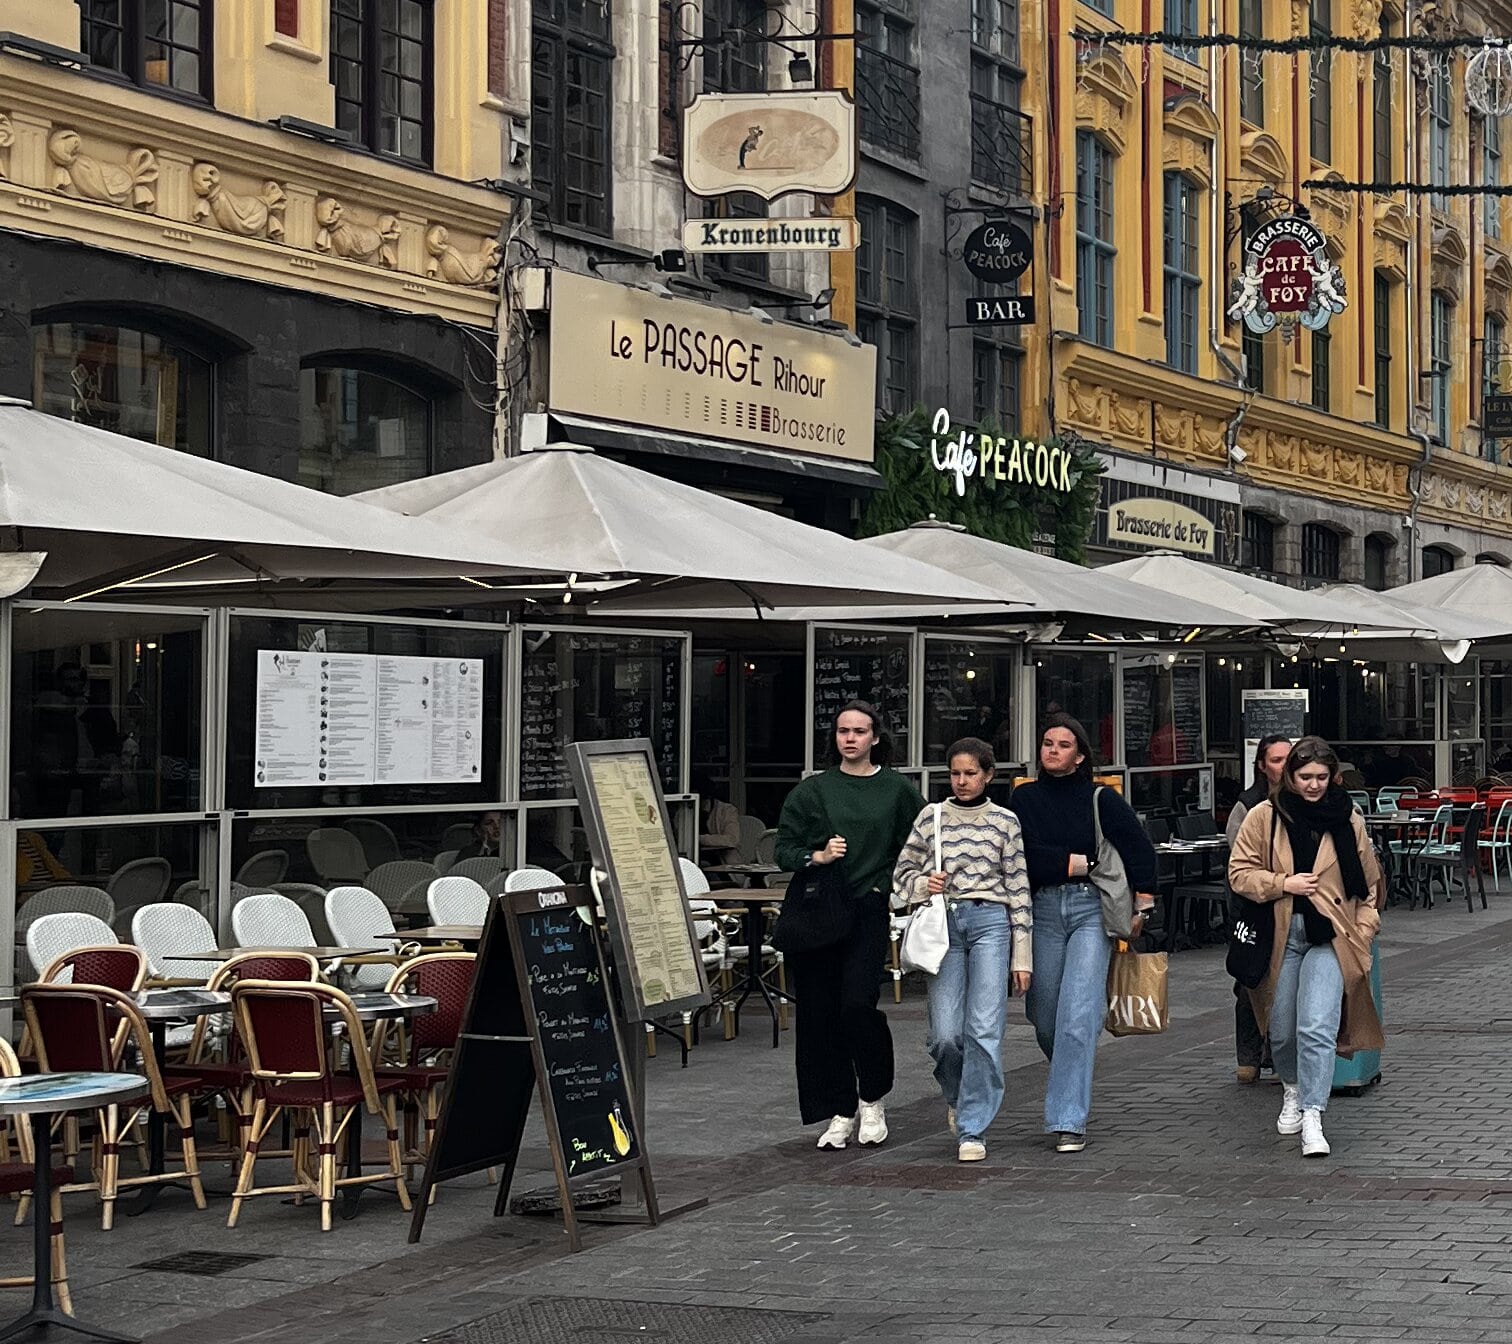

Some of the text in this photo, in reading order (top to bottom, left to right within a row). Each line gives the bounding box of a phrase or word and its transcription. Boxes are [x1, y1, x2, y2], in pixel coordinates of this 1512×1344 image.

[701, 222, 841, 248] Kronenbourg
[983, 227, 1012, 254] Café
[1252, 221, 1319, 253] BRASSERIE
[968, 250, 1027, 270] PEACOCK
[1281, 274, 1296, 284] de
[1270, 286, 1307, 303] FOY
[975, 300, 1026, 320] BAR
[610, 318, 826, 399] Le PASSAGE Rihour
[771, 407, 846, 446] Brasserie
[931, 407, 1072, 497] Café PEACOCK
[1116, 509, 1209, 550] Brasserie de Foy
